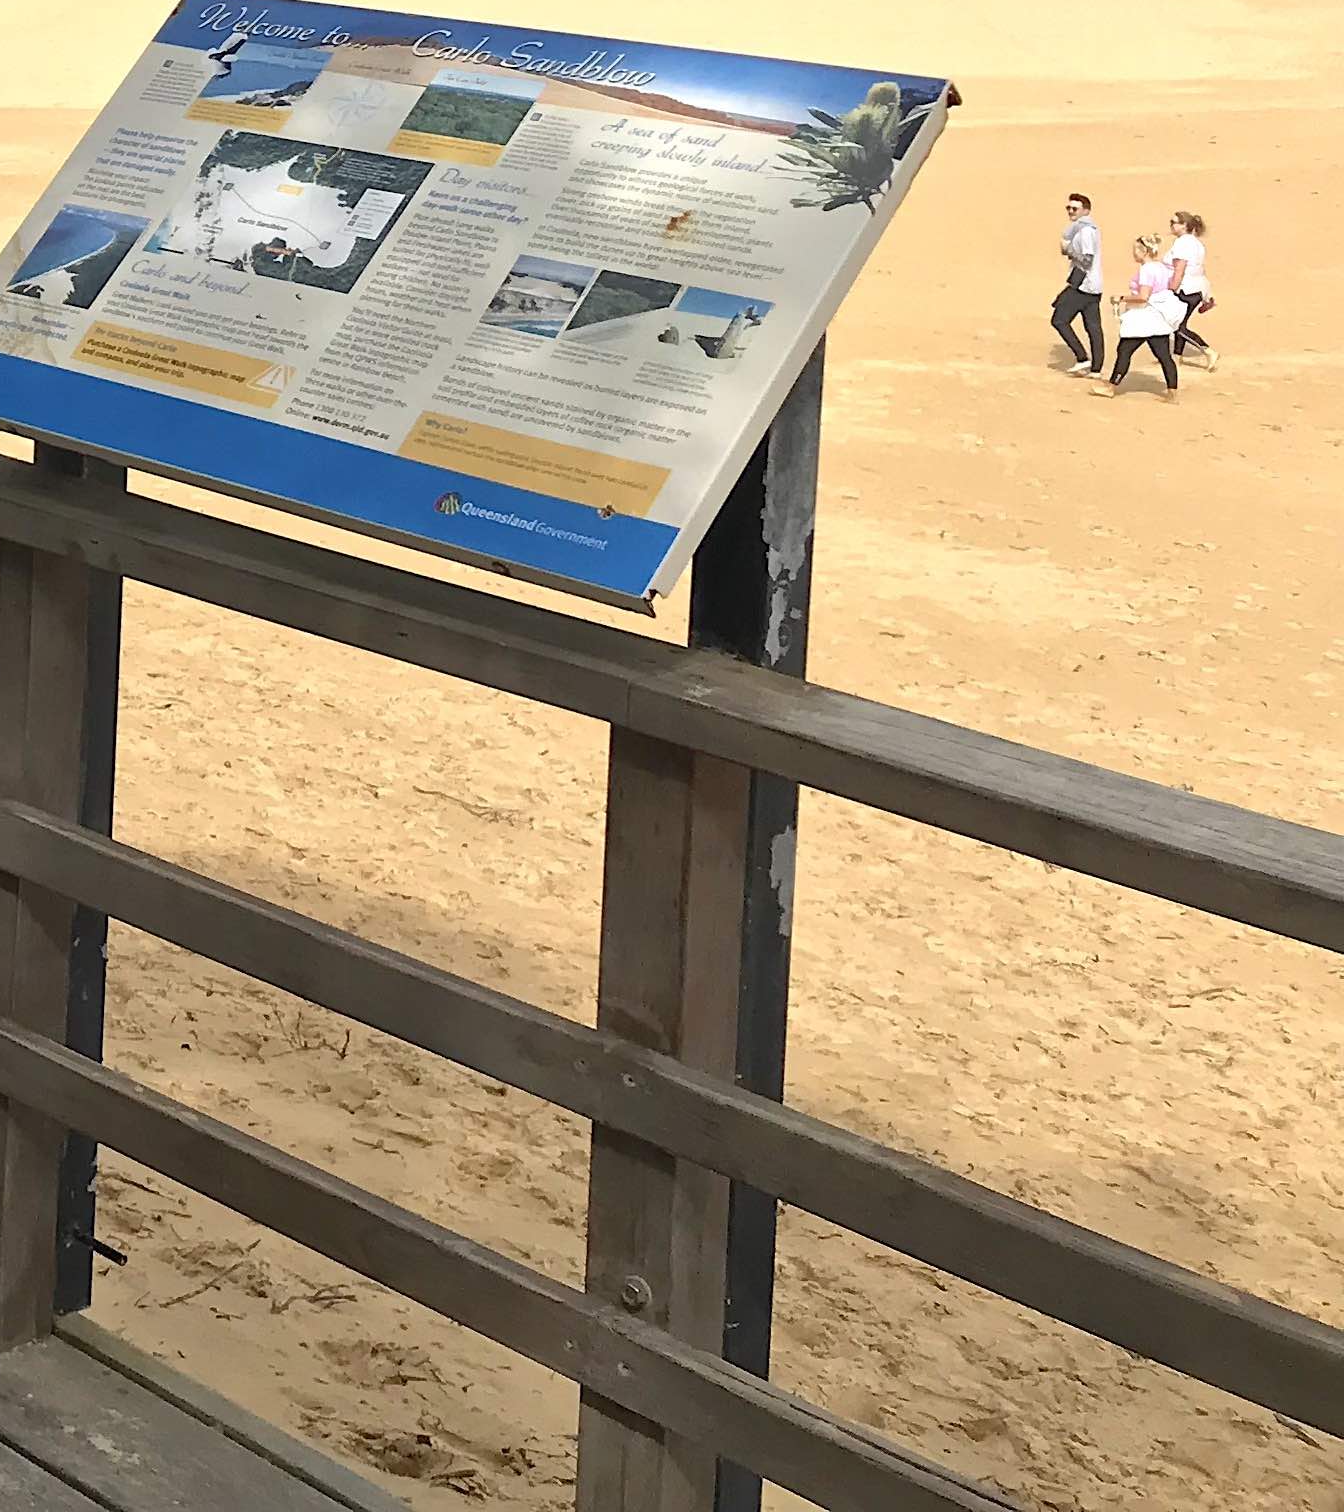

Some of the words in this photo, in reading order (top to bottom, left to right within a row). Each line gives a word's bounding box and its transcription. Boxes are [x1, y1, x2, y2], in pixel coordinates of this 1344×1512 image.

[197, 3, 313, 42] Welcome
[412, 29, 490, 65] Carlo
[499, 42, 656, 88] Sandblow
[591, 140, 650, 159] creeping
[656, 144, 707, 166] slowly
[629, 127, 653, 137] sea
[658, 126, 679, 144] of
[681, 133, 725, 148] sand
[462, 501, 537, 532] Queensland
[535, 521, 609, 552] Government
